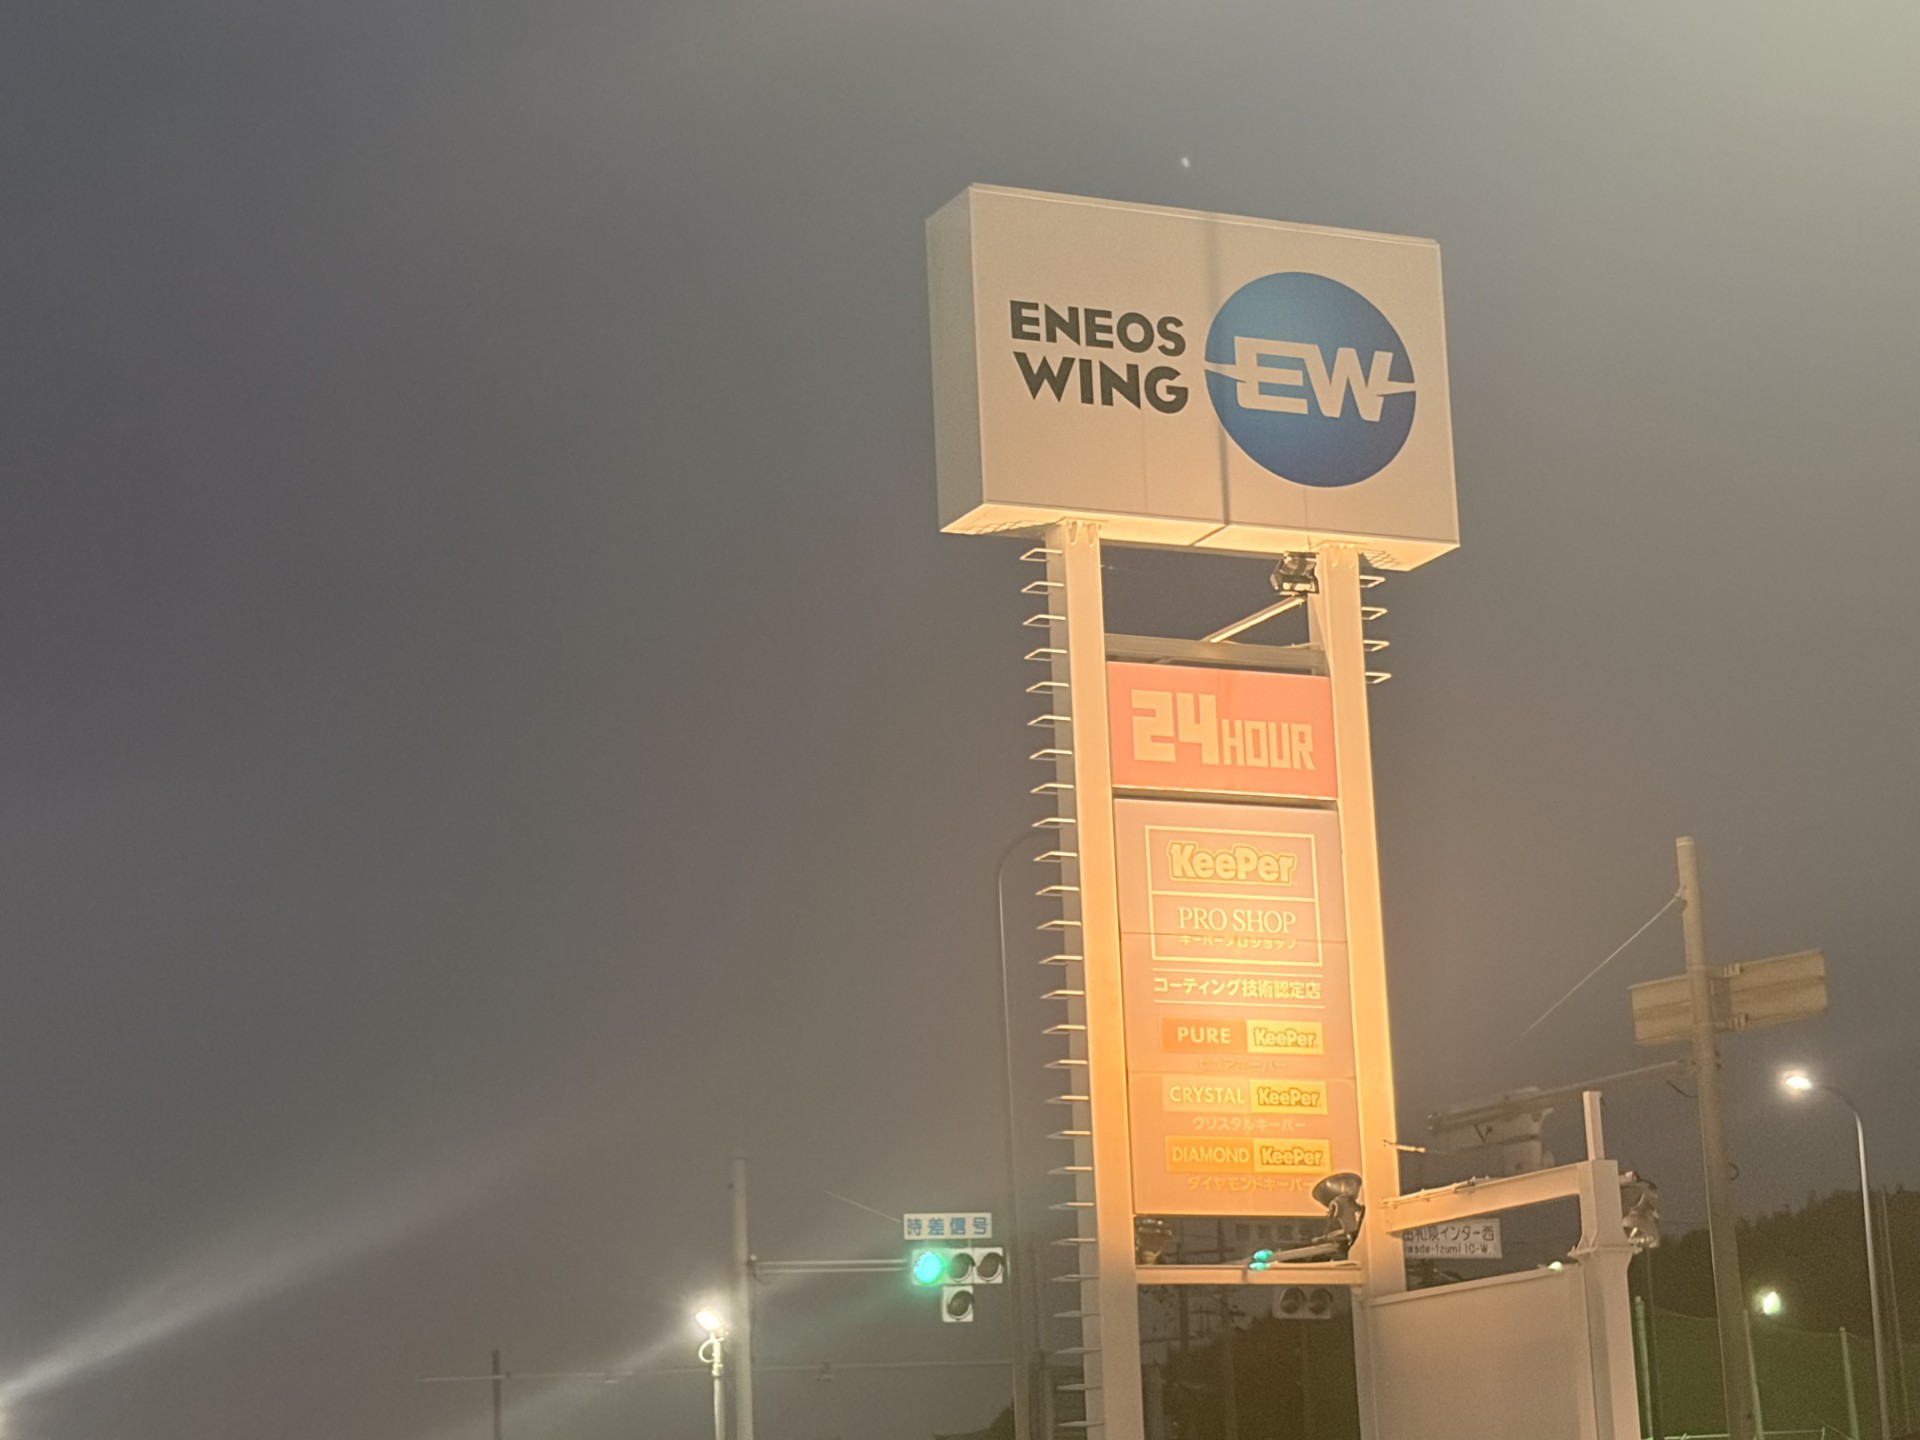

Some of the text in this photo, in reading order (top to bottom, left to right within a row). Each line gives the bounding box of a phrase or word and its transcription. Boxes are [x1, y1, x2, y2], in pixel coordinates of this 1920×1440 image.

[1010, 300, 1186, 357] ENEOS
[1013, 351, 1189, 414] WING
[1204, 335, 1416, 422] EW
[1167, 841, 1296, 886] KeePer
[1178, 907, 1296, 933] PRO SHOP
[1153, 977, 1321, 999] コーティング技術認定店
[1177, 1026, 1317, 1048] PURE KeePer
[1169, 1086, 1320, 1108] CRYSTAL KeePer
[1192, 1116, 1307, 1132] クリスタルキーパー
[1172, 1146, 1324, 1167] DIAMOND KeePer
[1187, 1176, 1314, 1193] ダイヤモンドキーパー
